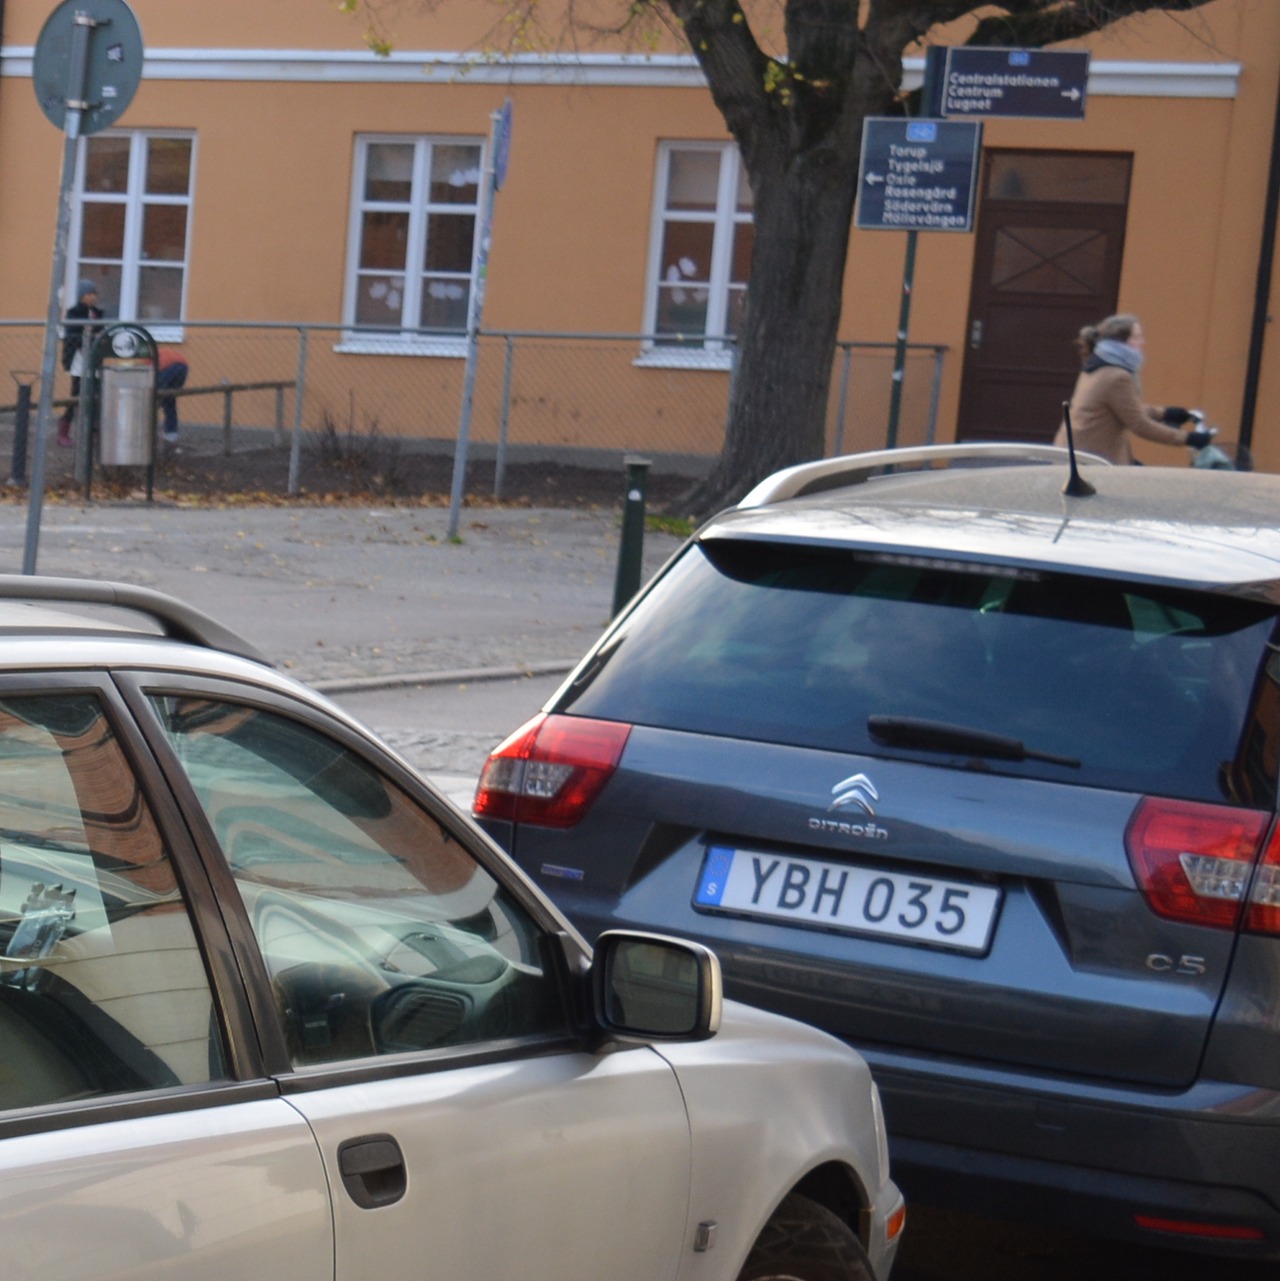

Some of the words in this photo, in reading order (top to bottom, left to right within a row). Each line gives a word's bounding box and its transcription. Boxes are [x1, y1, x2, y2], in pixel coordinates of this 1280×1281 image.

[948, 72, 1060, 88] Centralstationen
[947, 85, 1004, 98] Centrum
[946, 97, 992, 112] Lugnet
[888, 144, 927, 158] Torup
[887, 159, 945, 174] Tygelsjö
[885, 173, 917, 186] Oxie
[884, 185, 957, 200] Rosengård
[882, 211, 966, 227] Möllevången
[706, 882, 718, 896] S
[751, 857, 849, 917] YBH
[862, 877, 970, 935] 035
[1146, 954, 1206, 974] C5
